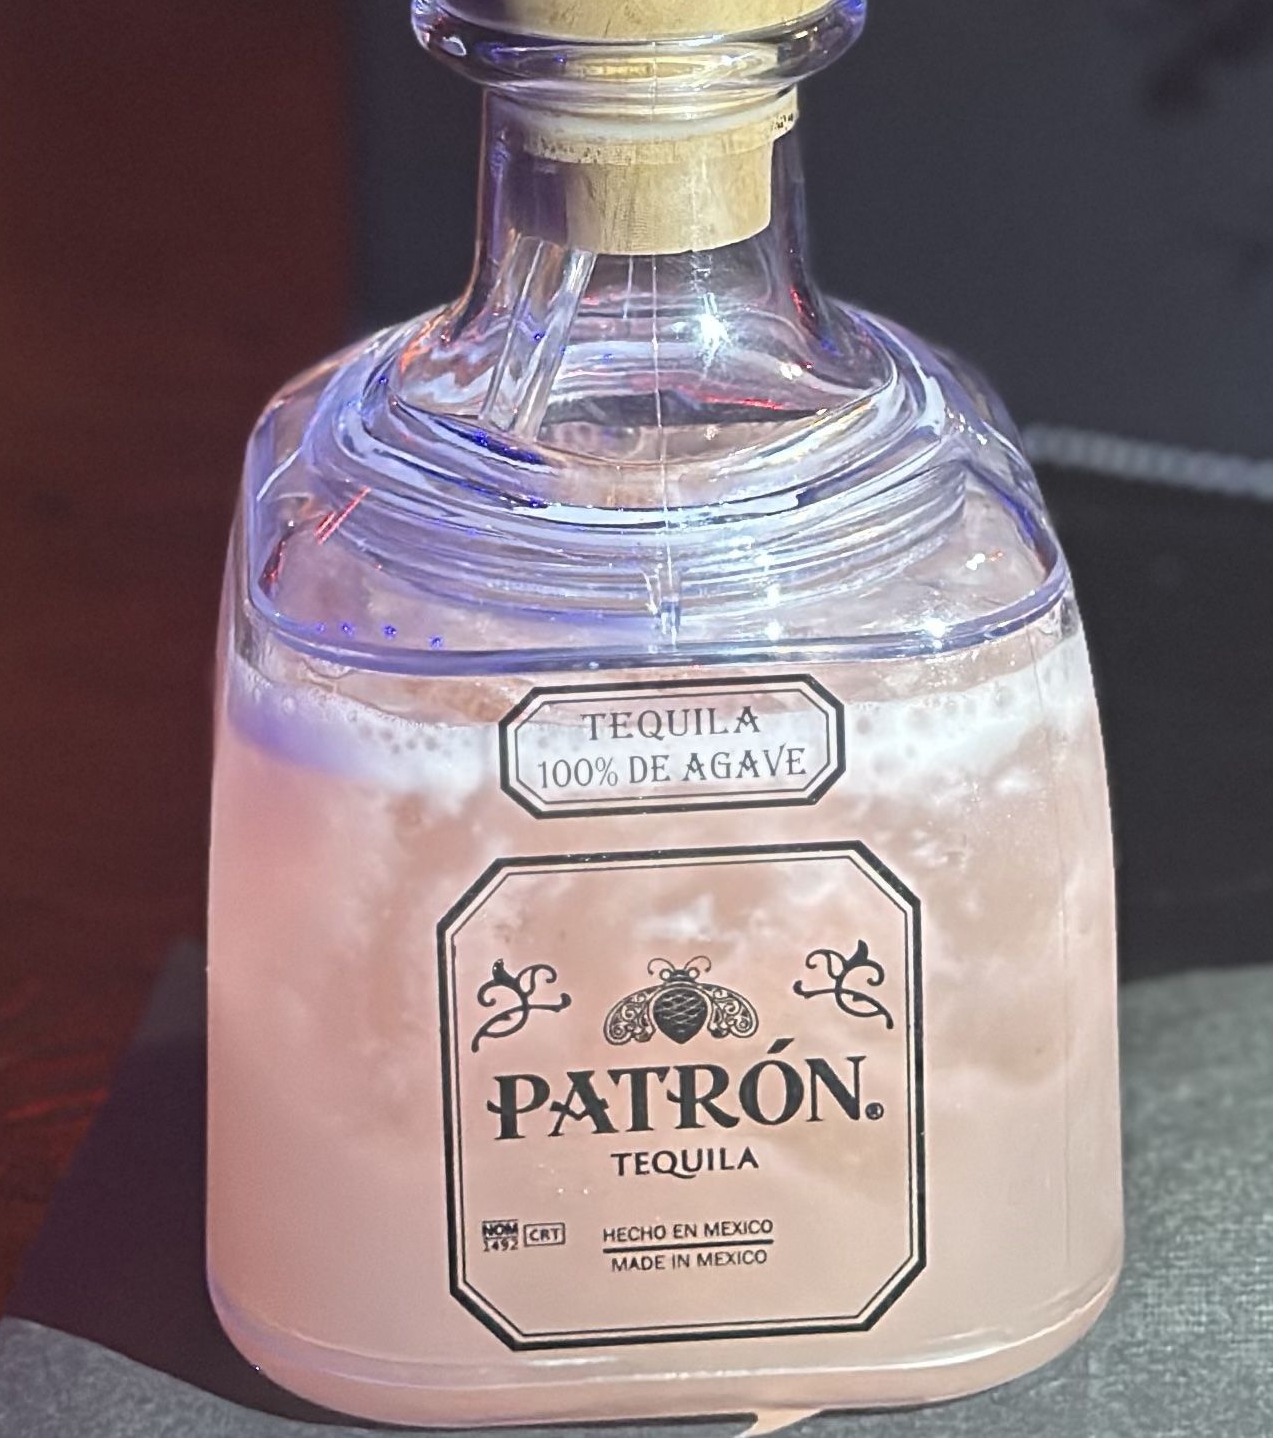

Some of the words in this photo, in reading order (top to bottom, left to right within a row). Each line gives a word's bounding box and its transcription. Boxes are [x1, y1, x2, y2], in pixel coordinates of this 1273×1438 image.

[580, 705, 761, 741] TEQUILA
[537, 757, 619, 789] 100%
[629, 754, 671, 784] DE
[682, 743, 807, 781] AGAVE
[610, 1147, 760, 1179] TEQUILA
[482, 1222, 519, 1236] NOM
[529, 1227, 560, 1242] CRT
[603, 1224, 667, 1243] HECHO
[673, 1223, 697, 1239] EN
[704, 1219, 774, 1237] MEXICO
[483, 1236, 519, 1252] 1492
[612, 1254, 666, 1272] MADE
[672, 1253, 690, 1268] IN
[696, 1249, 768, 1267] MEXICO
